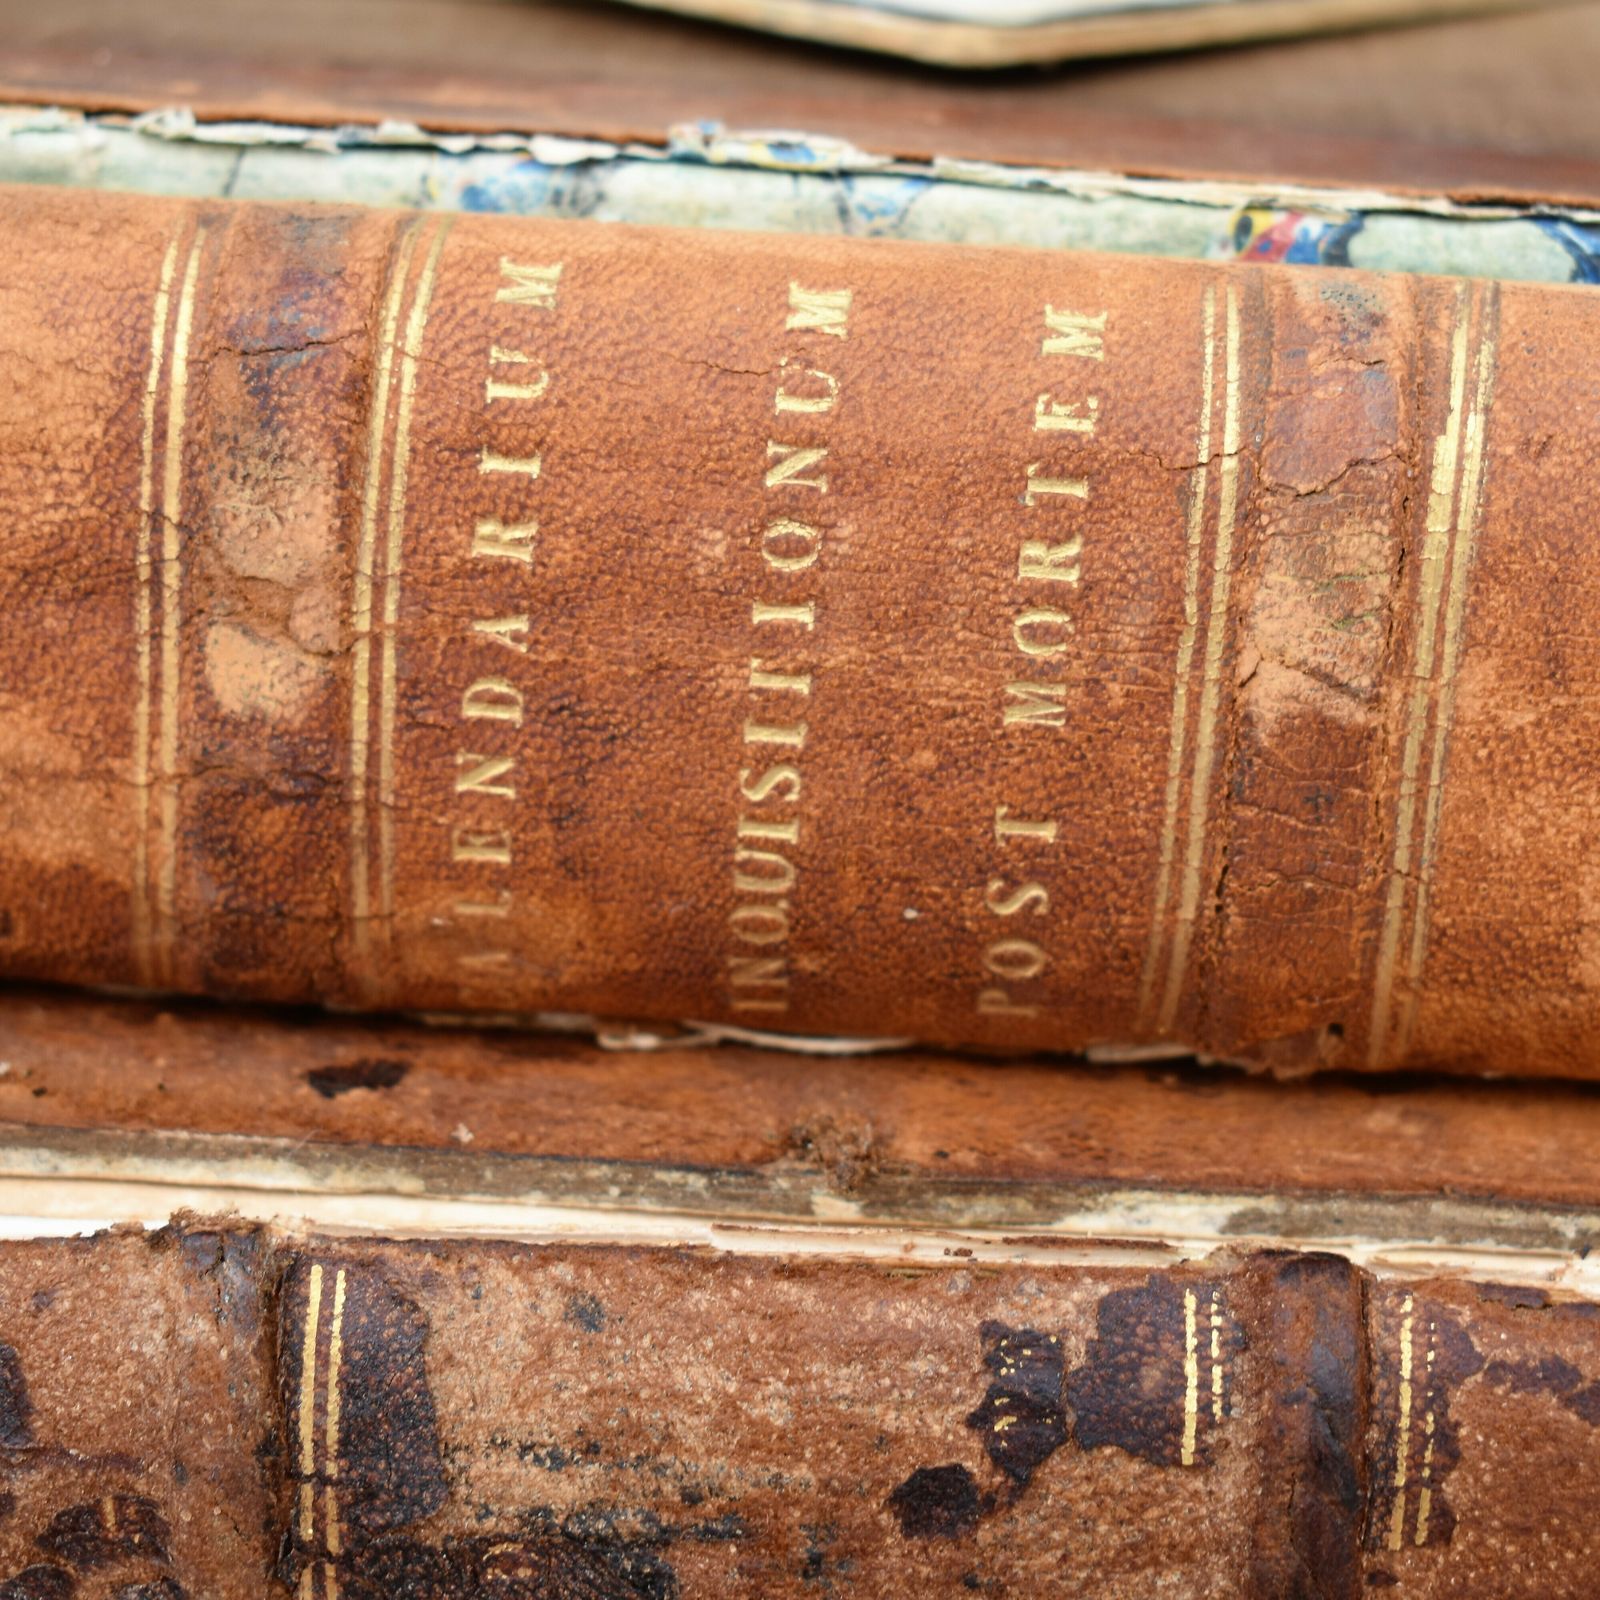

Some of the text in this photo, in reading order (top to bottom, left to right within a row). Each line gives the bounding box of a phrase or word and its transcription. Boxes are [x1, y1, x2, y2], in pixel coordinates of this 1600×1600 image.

[450, 256, 563, 1000] ALENDARIUM
[728, 282, 853, 1013] INQUISITIONUM
[978, 303, 1108, 1018] POST MORTEM
